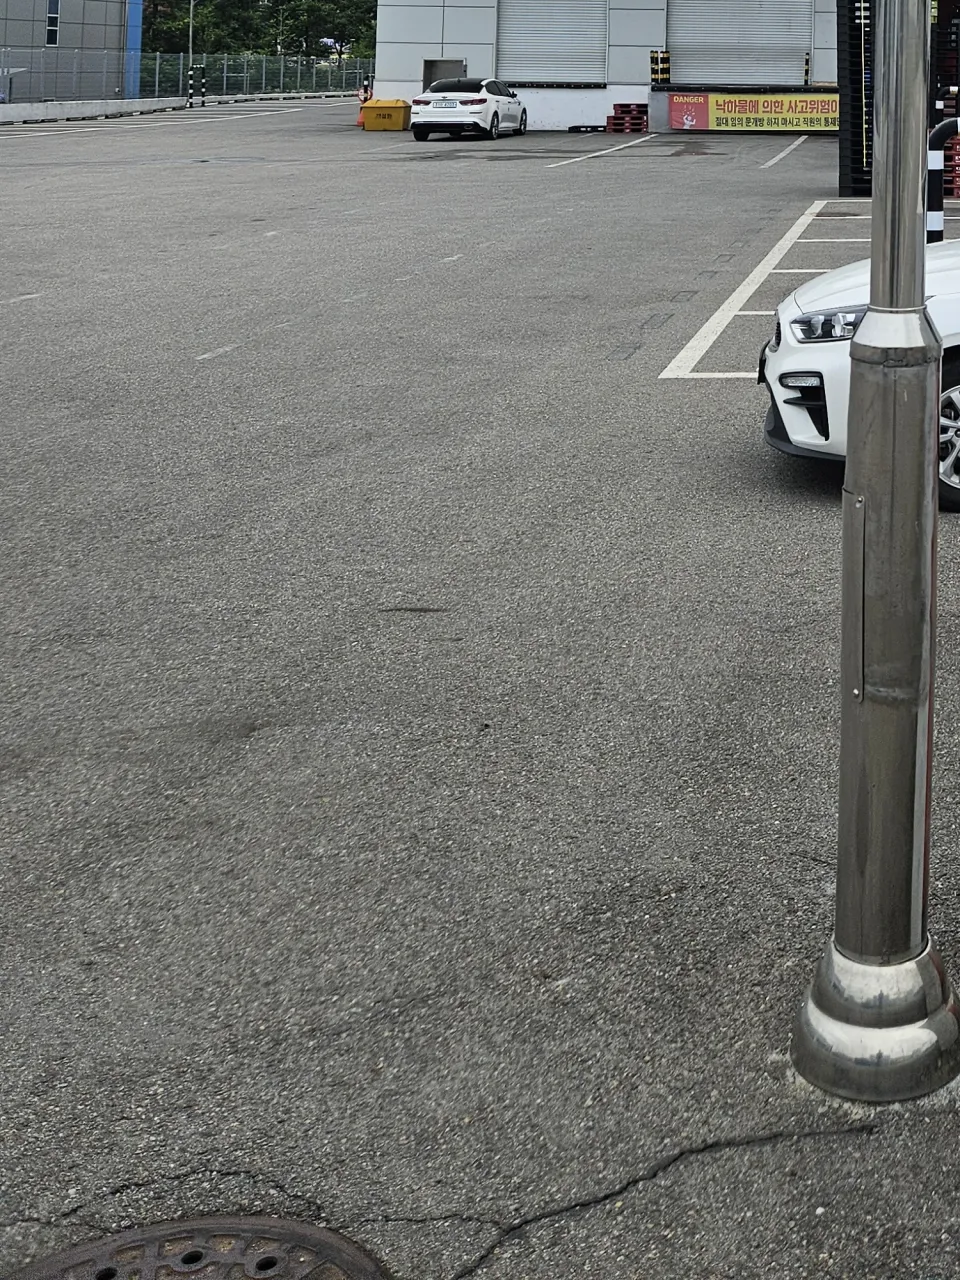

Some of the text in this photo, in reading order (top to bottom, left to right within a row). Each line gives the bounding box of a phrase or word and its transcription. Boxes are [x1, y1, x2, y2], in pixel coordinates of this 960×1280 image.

[673, 95, 704, 103] DANGER
[715, 99, 759, 114] 낙하물에
[762, 99, 784, 114] 의한
[766, 116, 779, 127] 하지
[780, 116, 801, 127] 마시고
[802, 116, 822, 127] 직원의
